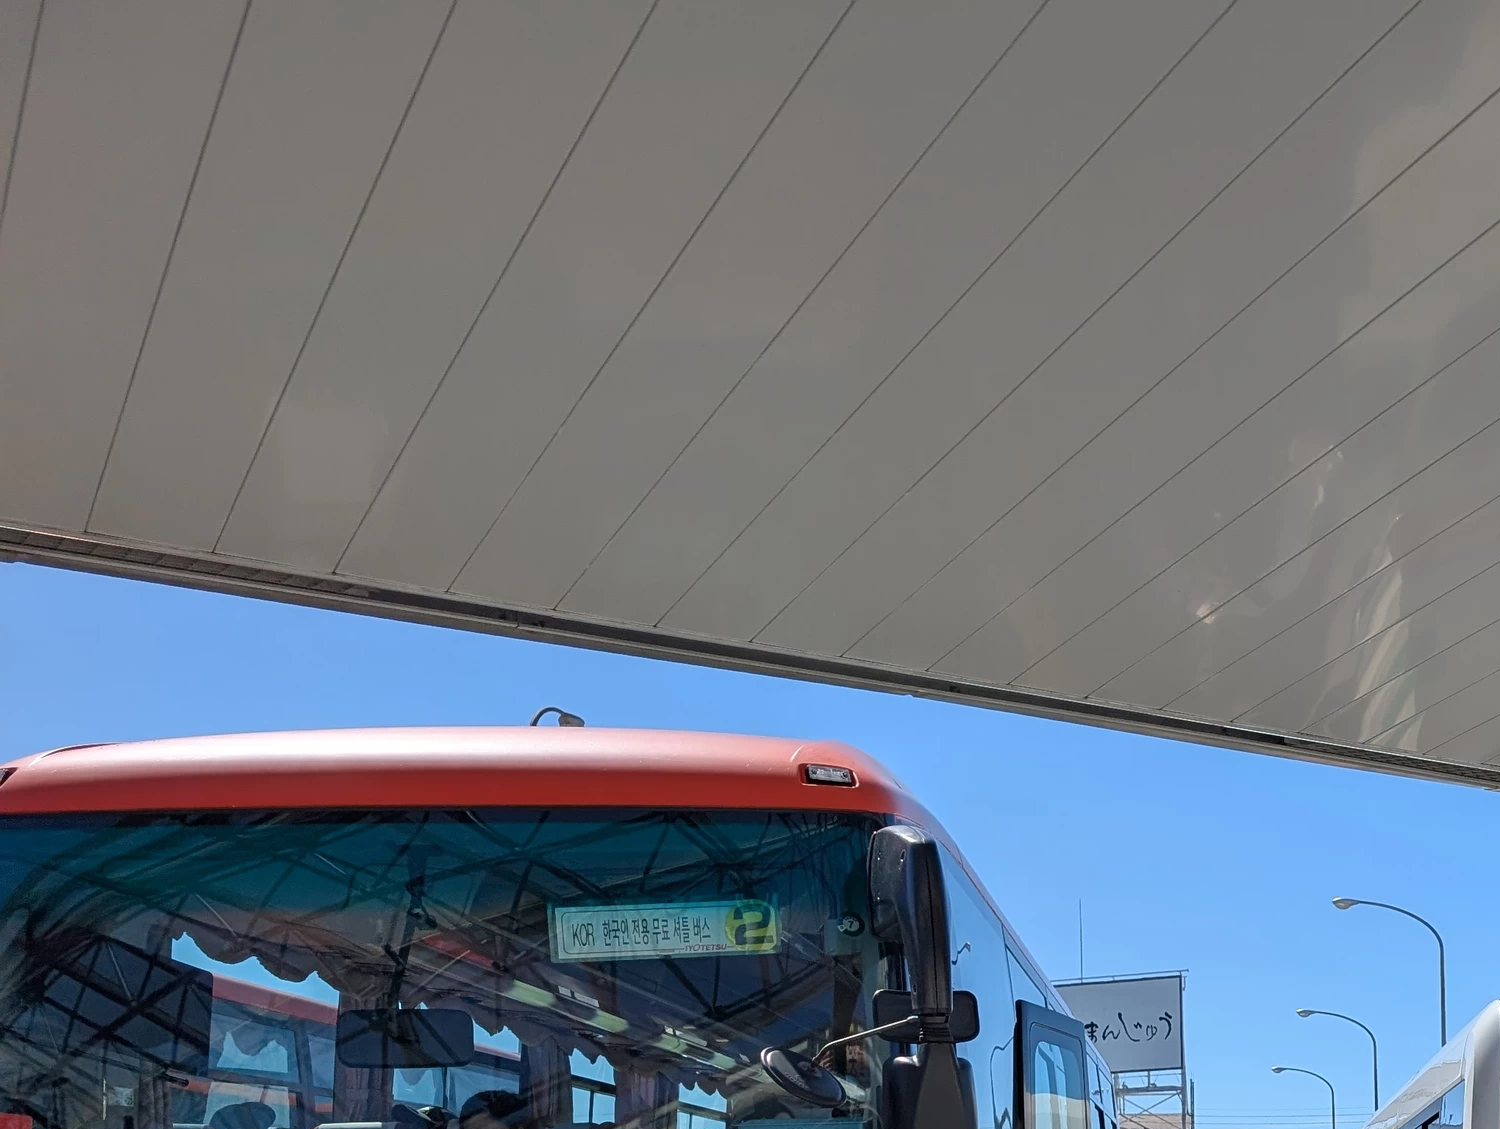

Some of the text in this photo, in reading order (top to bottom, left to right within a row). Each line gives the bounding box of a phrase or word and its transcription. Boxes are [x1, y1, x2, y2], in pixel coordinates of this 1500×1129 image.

[572, 915, 711, 947] KOR 한국인 전용 무료 셔틀 버스
[733, 903, 774, 946] 2
[684, 943, 727, 952] IYOTETSU
[1084, 1011, 1172, 1043] まんじゅう
